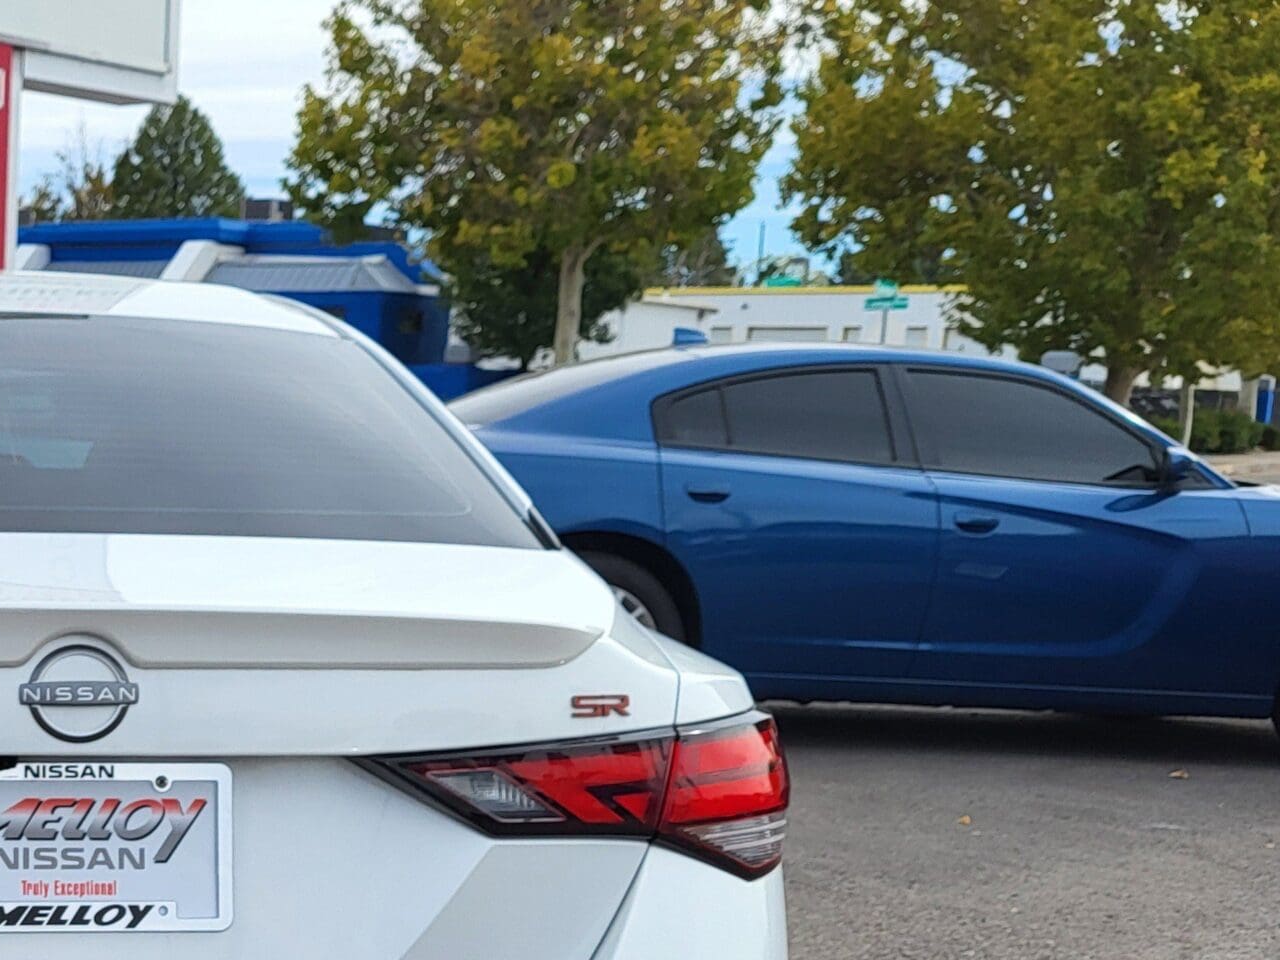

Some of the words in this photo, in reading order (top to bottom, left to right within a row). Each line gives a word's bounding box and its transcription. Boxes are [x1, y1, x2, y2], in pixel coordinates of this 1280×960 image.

[23, 686, 136, 702] NISSAN
[570, 694, 630, 718] SR
[24, 765, 114, 778] NISSAN
[21, 880, 49, 898] Truly
[54, 880, 117, 898] Exceptional
